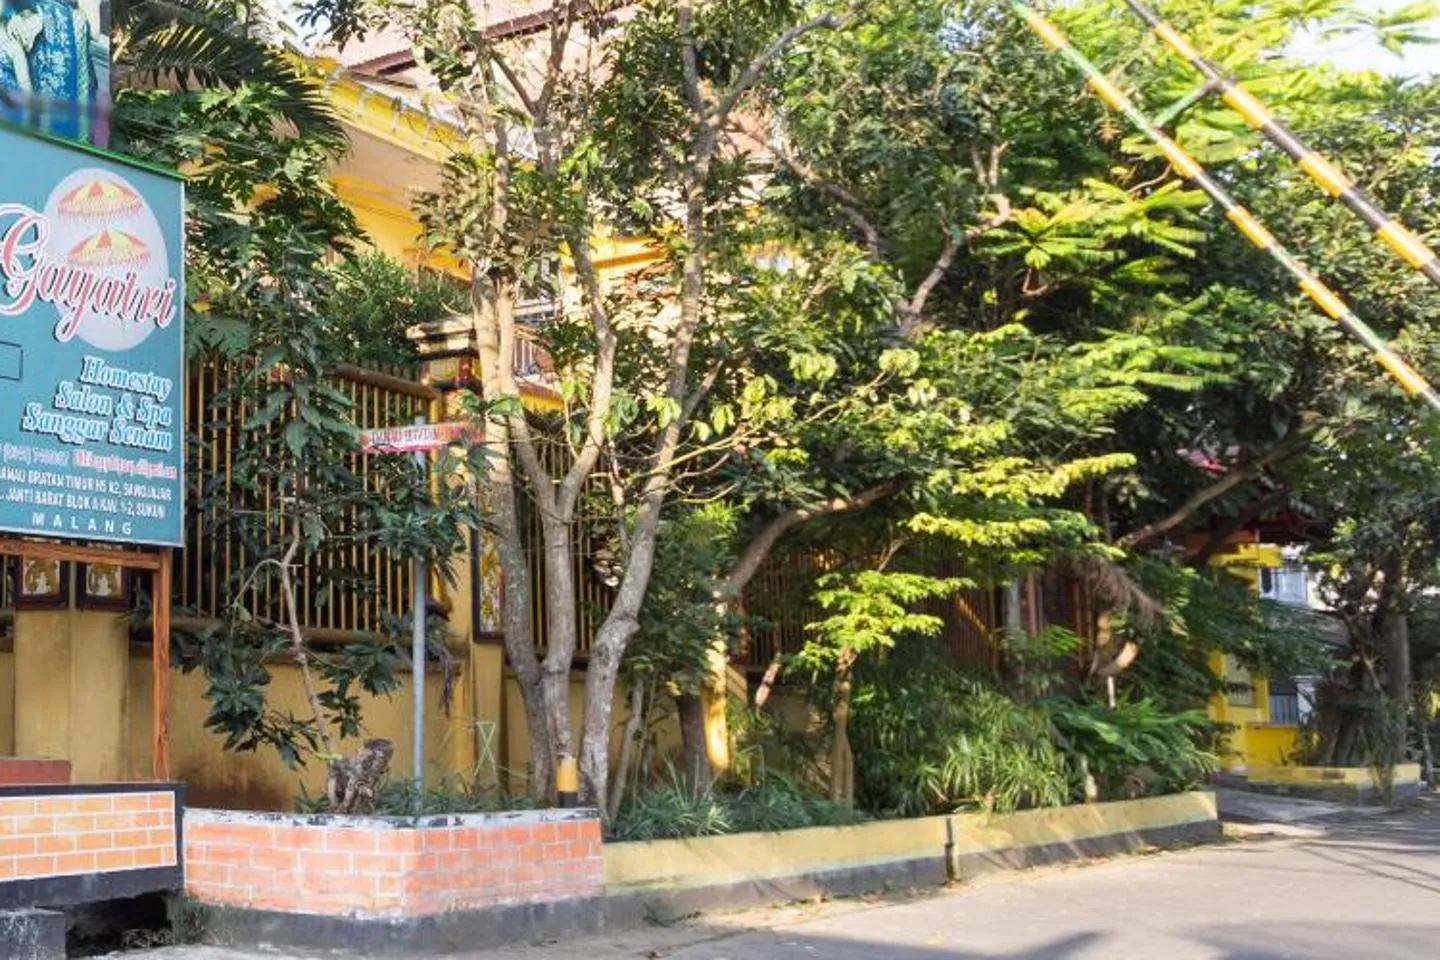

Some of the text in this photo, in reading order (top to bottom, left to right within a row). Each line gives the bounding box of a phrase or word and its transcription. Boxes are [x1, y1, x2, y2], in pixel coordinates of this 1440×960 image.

[80, 355, 173, 402] Homestay
[22, 402, 173, 452] Sanggar Senam
[55, 380, 172, 429] Salon & Spa
[32, 512, 132, 535] MALANG
